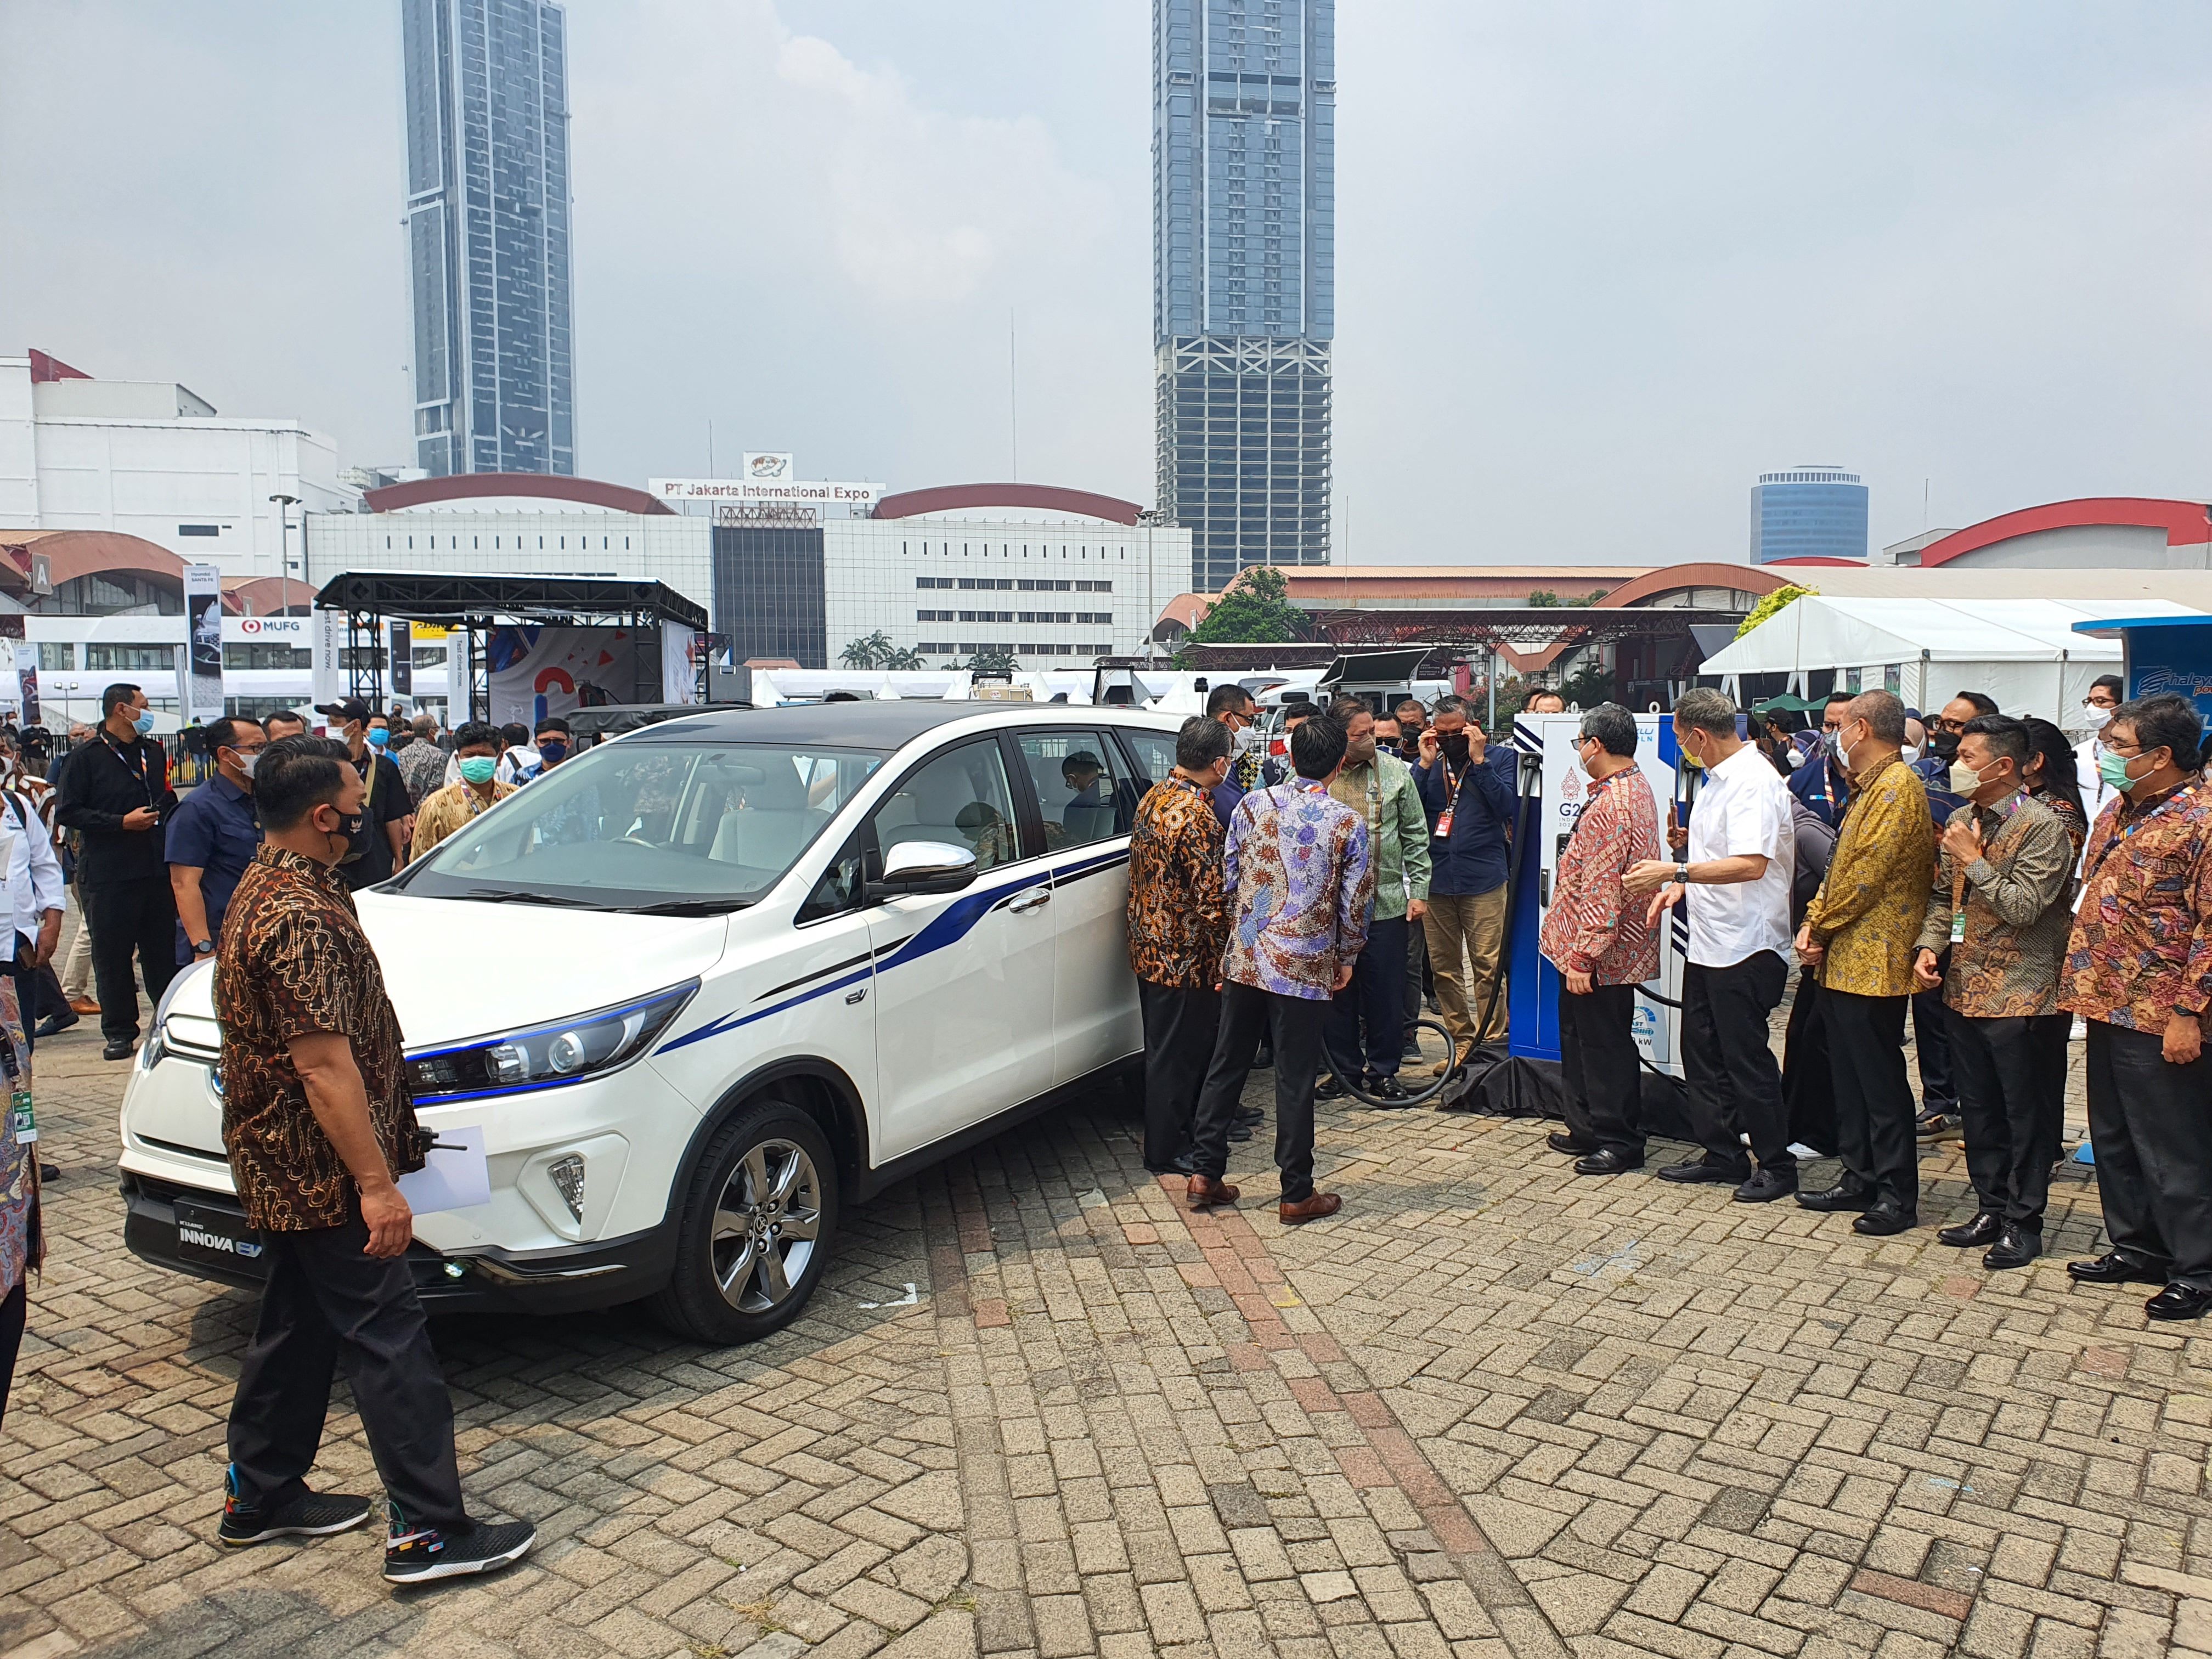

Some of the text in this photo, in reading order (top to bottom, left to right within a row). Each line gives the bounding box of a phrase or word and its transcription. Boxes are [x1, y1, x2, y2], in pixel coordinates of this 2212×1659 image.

[665, 483, 870, 501] PT Jakarta International Expo
[37, 563, 47, 585] A
[263, 621, 300, 631] MUFG
[1638, 1037, 1652, 1046] kW
[179, 1227, 262, 1258] INNOVA EV
